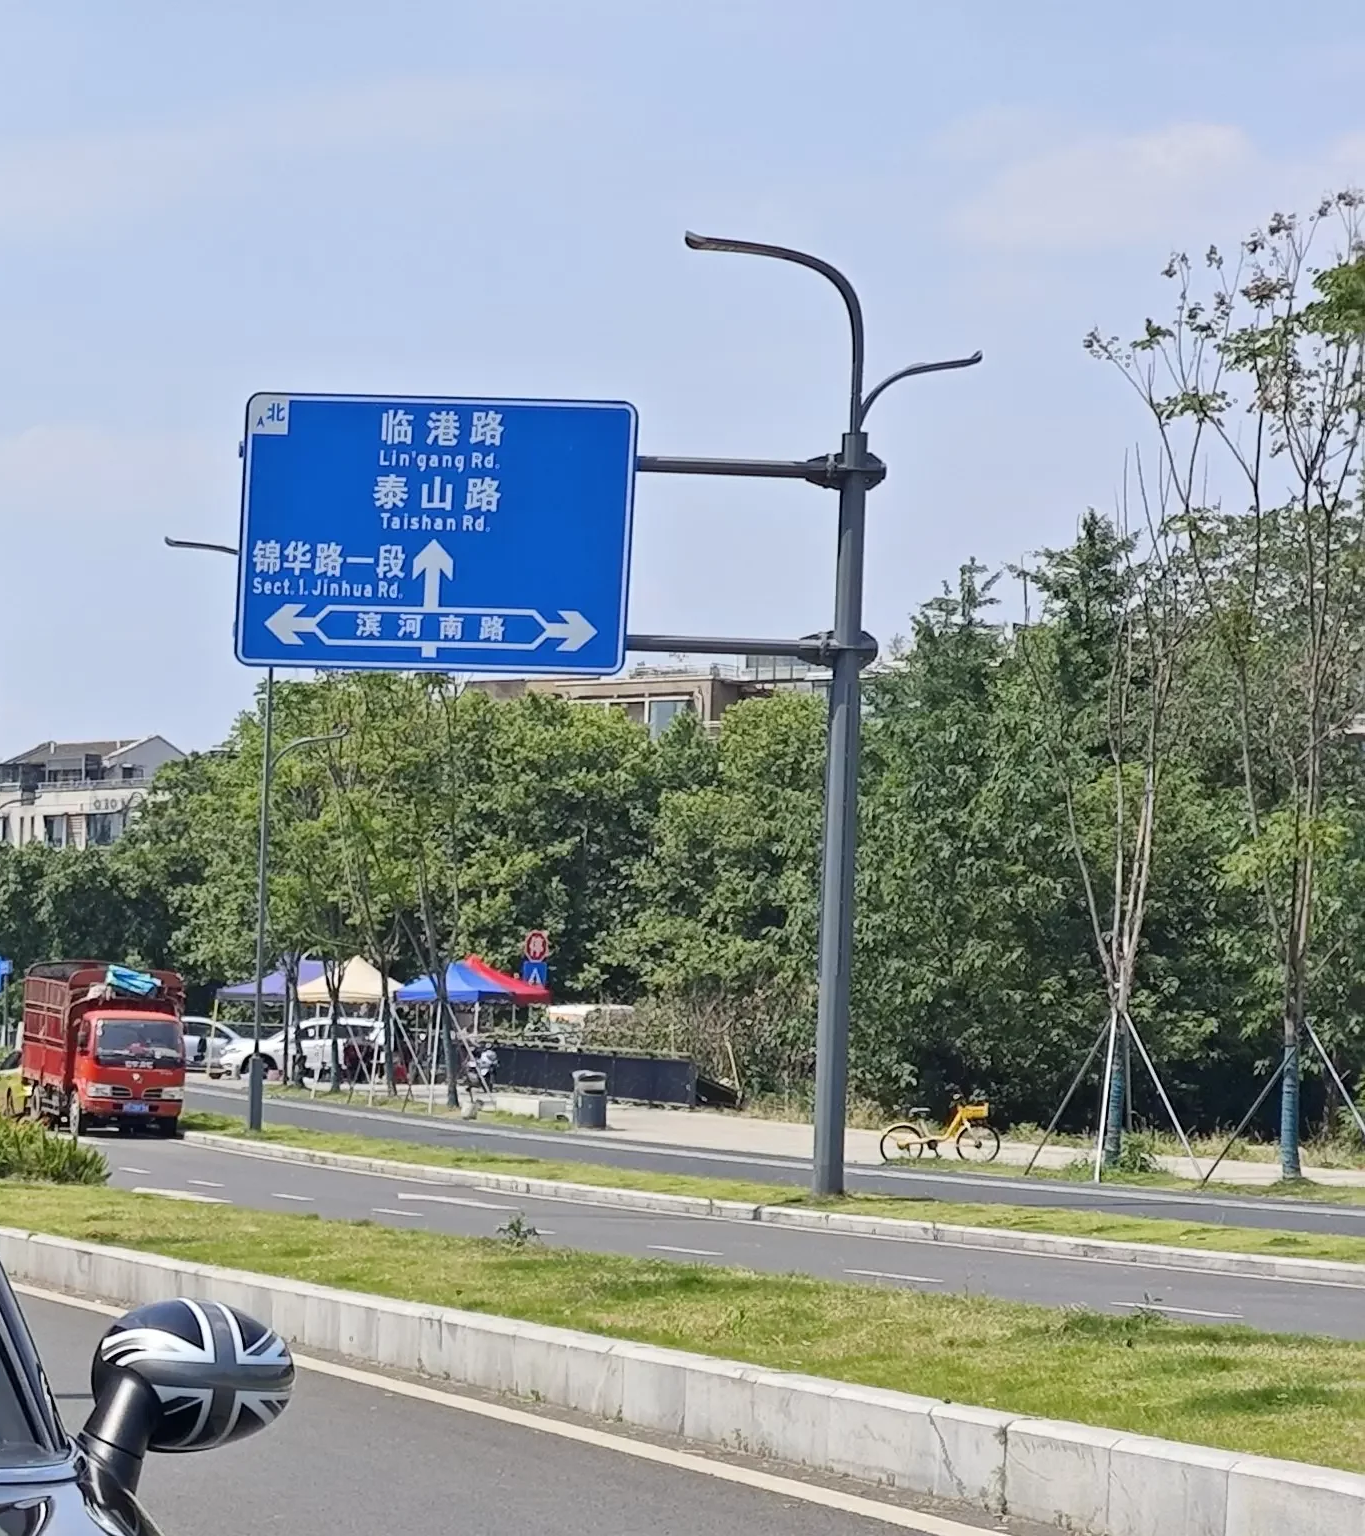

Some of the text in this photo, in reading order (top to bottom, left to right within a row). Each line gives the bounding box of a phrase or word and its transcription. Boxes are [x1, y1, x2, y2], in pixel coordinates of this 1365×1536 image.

[266, 402, 286, 422] 北
[379, 409, 505, 447] 临港路
[378, 449, 465, 472] Lin'gang
[372, 473, 502, 513] 泰山路
[380, 512, 457, 532] Taishan
[252, 539, 406, 579] 锦华路一段
[355, 612, 506, 642] 滨河南路
